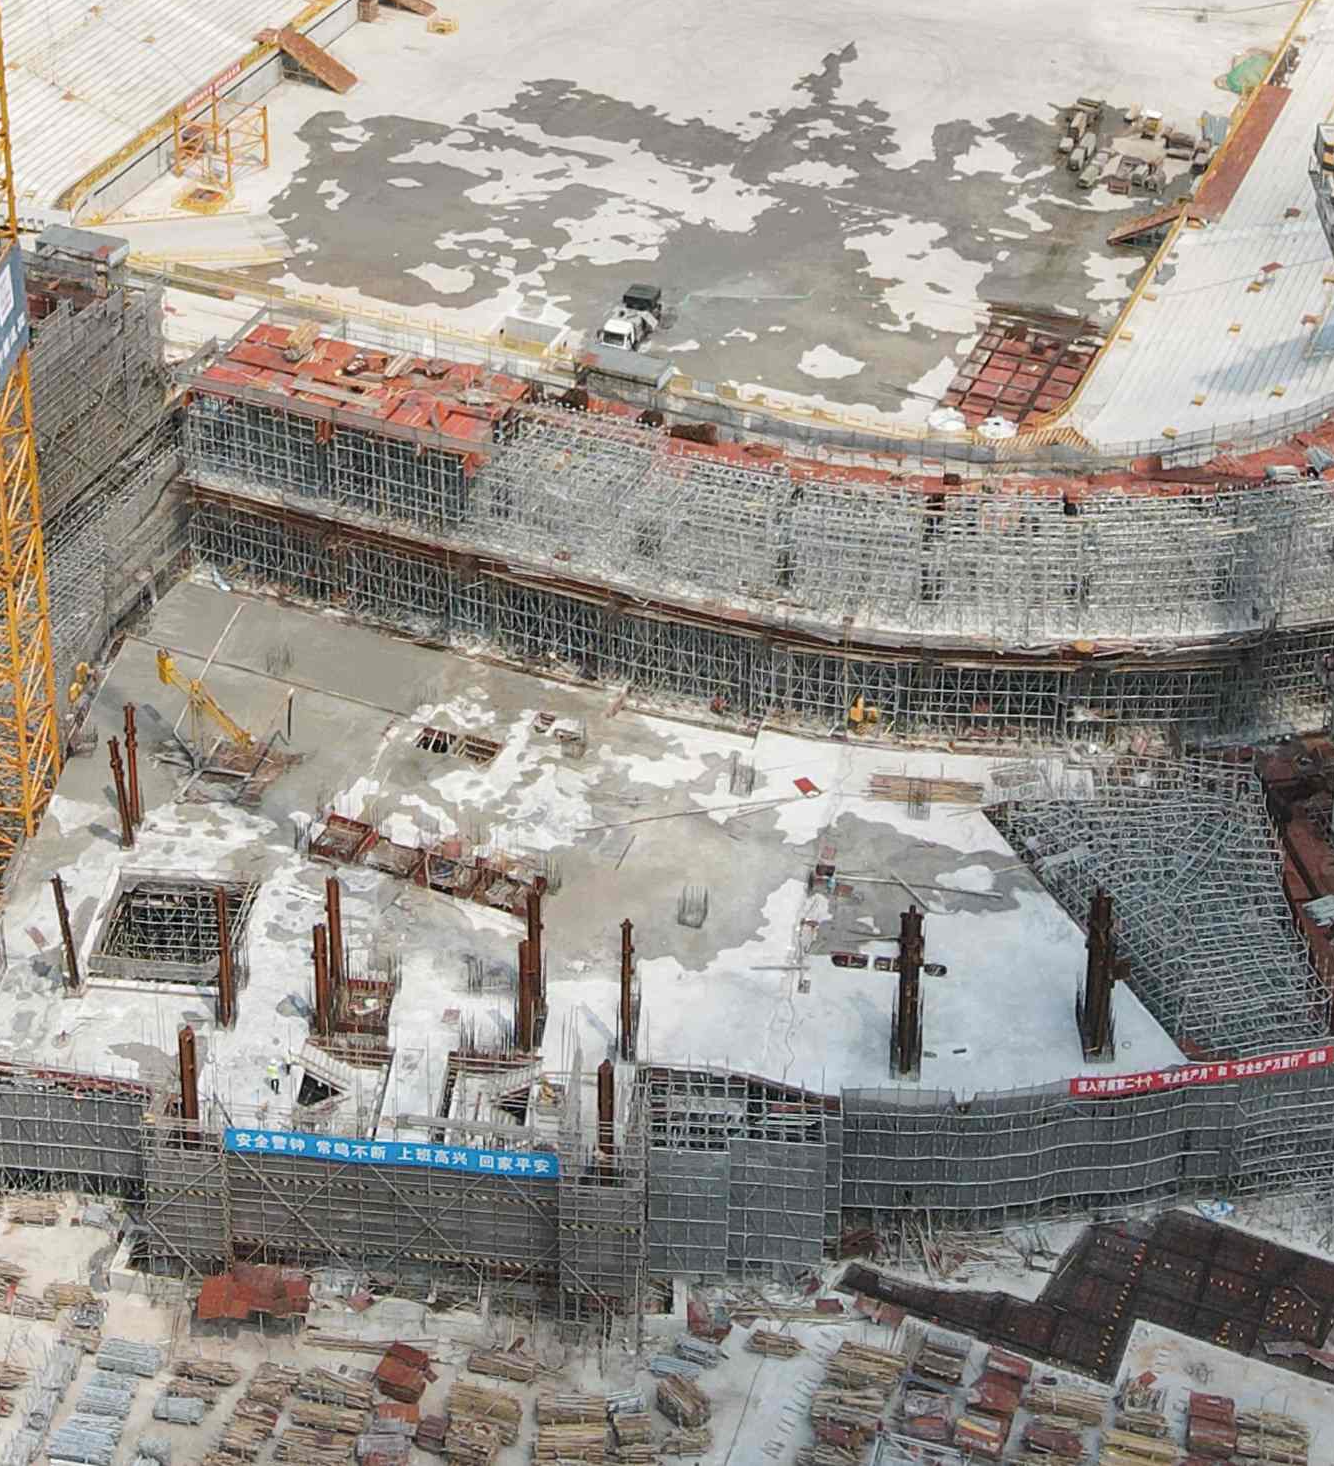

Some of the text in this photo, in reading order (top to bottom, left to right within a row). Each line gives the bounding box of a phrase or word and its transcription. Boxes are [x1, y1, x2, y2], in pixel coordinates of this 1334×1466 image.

[235, 1132, 550, 1173] 安全警钟 常鸣不断 上班高兴 回家平安
